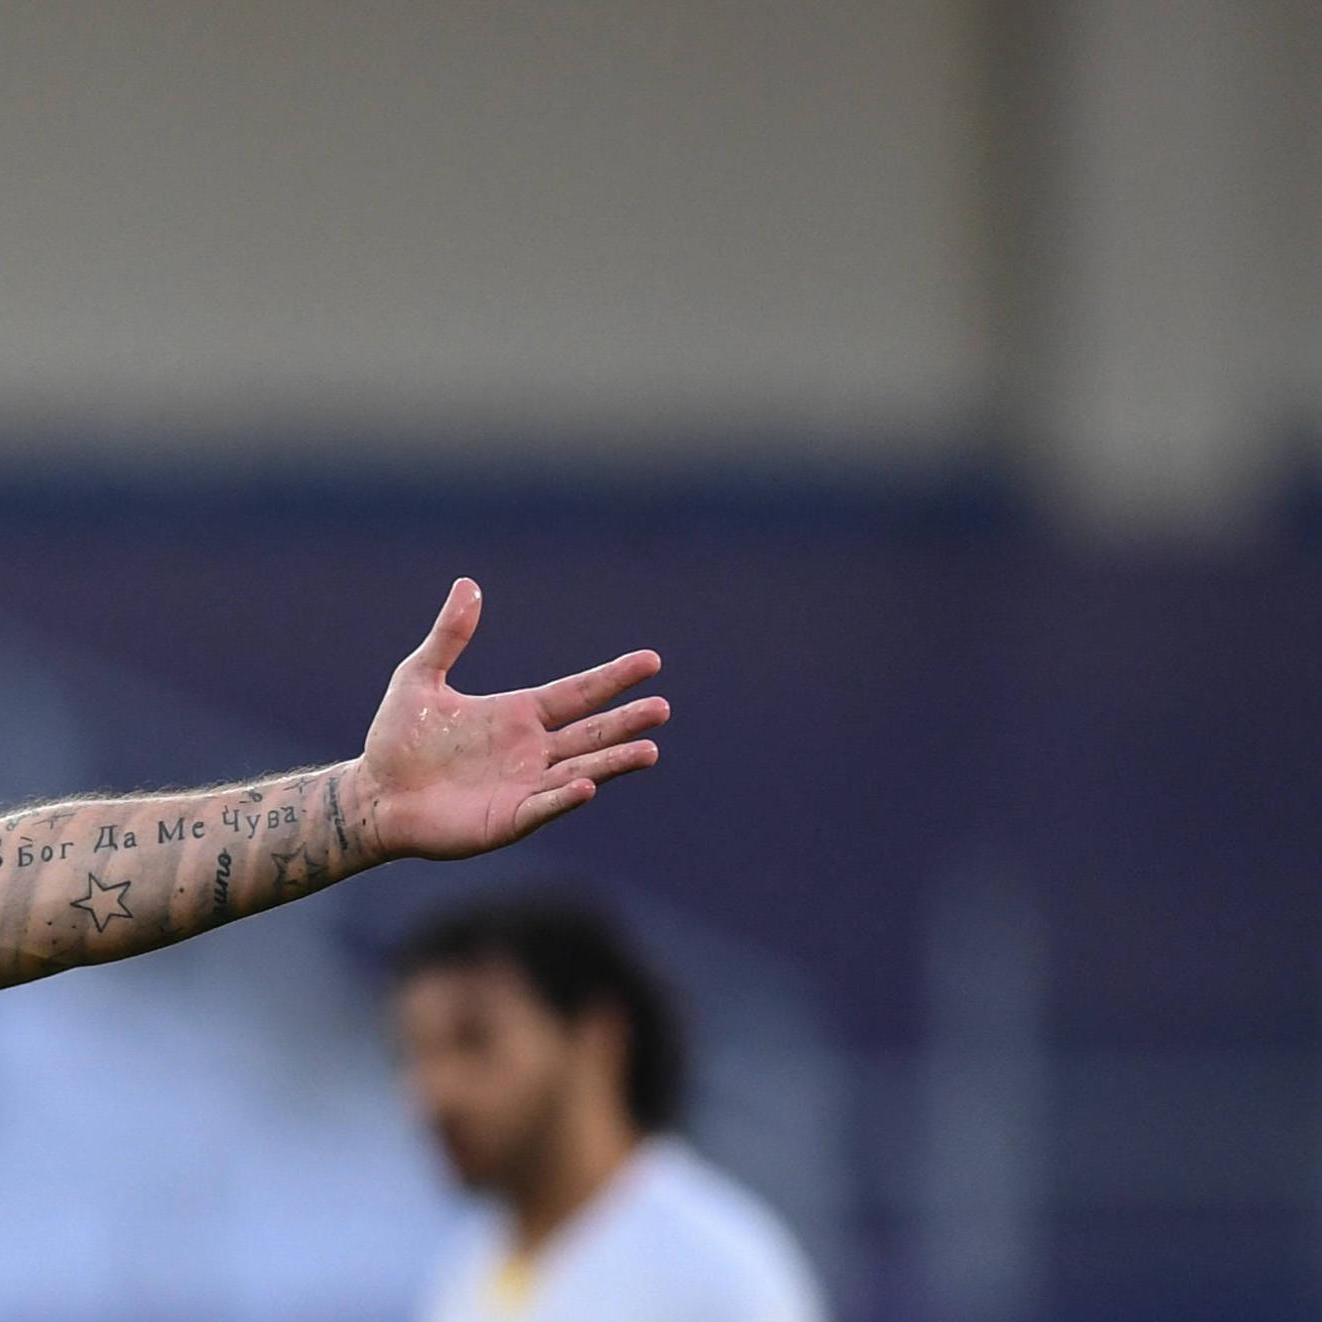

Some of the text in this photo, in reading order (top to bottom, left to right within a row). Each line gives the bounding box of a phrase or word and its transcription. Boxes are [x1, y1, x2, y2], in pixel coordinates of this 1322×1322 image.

[18, 838, 74, 867] Бог
[94, 825, 137, 853] Да
[221, 805, 299, 839] Чува
